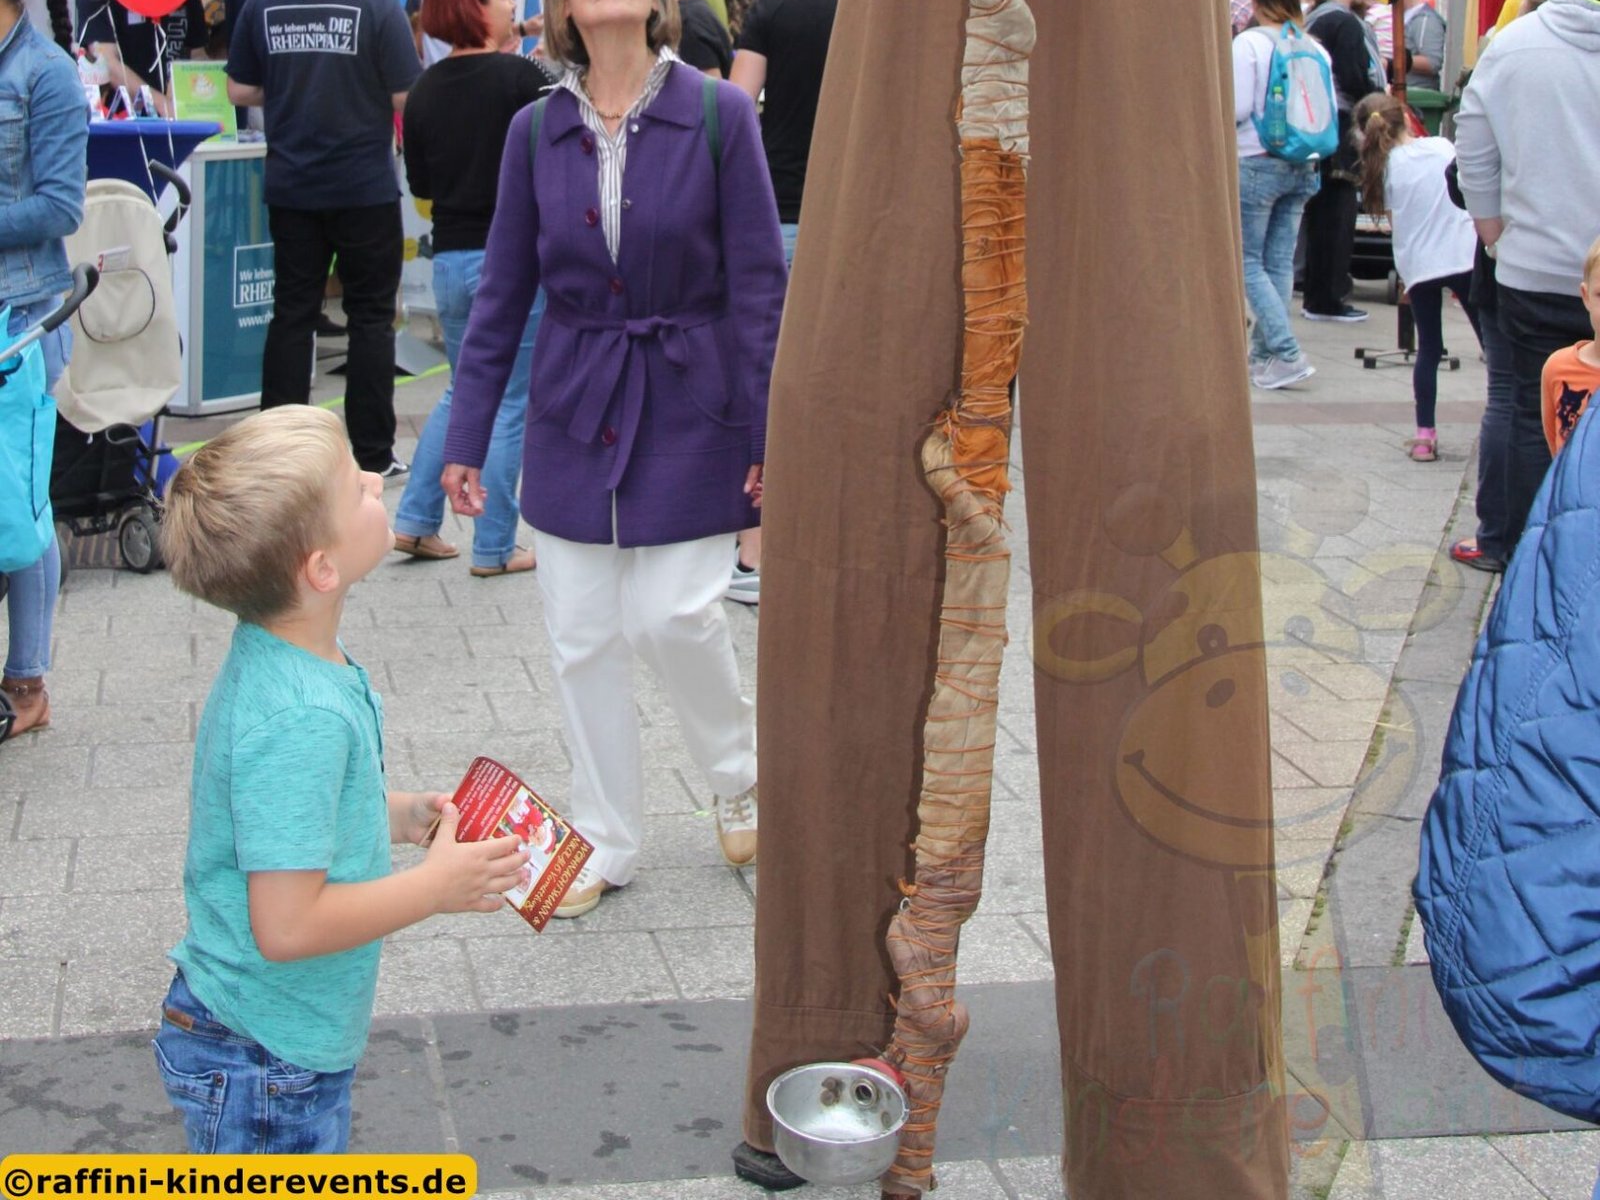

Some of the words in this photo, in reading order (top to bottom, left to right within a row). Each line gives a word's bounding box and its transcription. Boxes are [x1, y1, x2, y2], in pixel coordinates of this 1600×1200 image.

[269, 24, 283, 35] Wir
[284, 22, 307, 33] leben
[328, 16, 353, 35] DIE
[271, 33, 352, 50] RHEINPFALZ
[523, 870, 559, 912] Vermittlung
